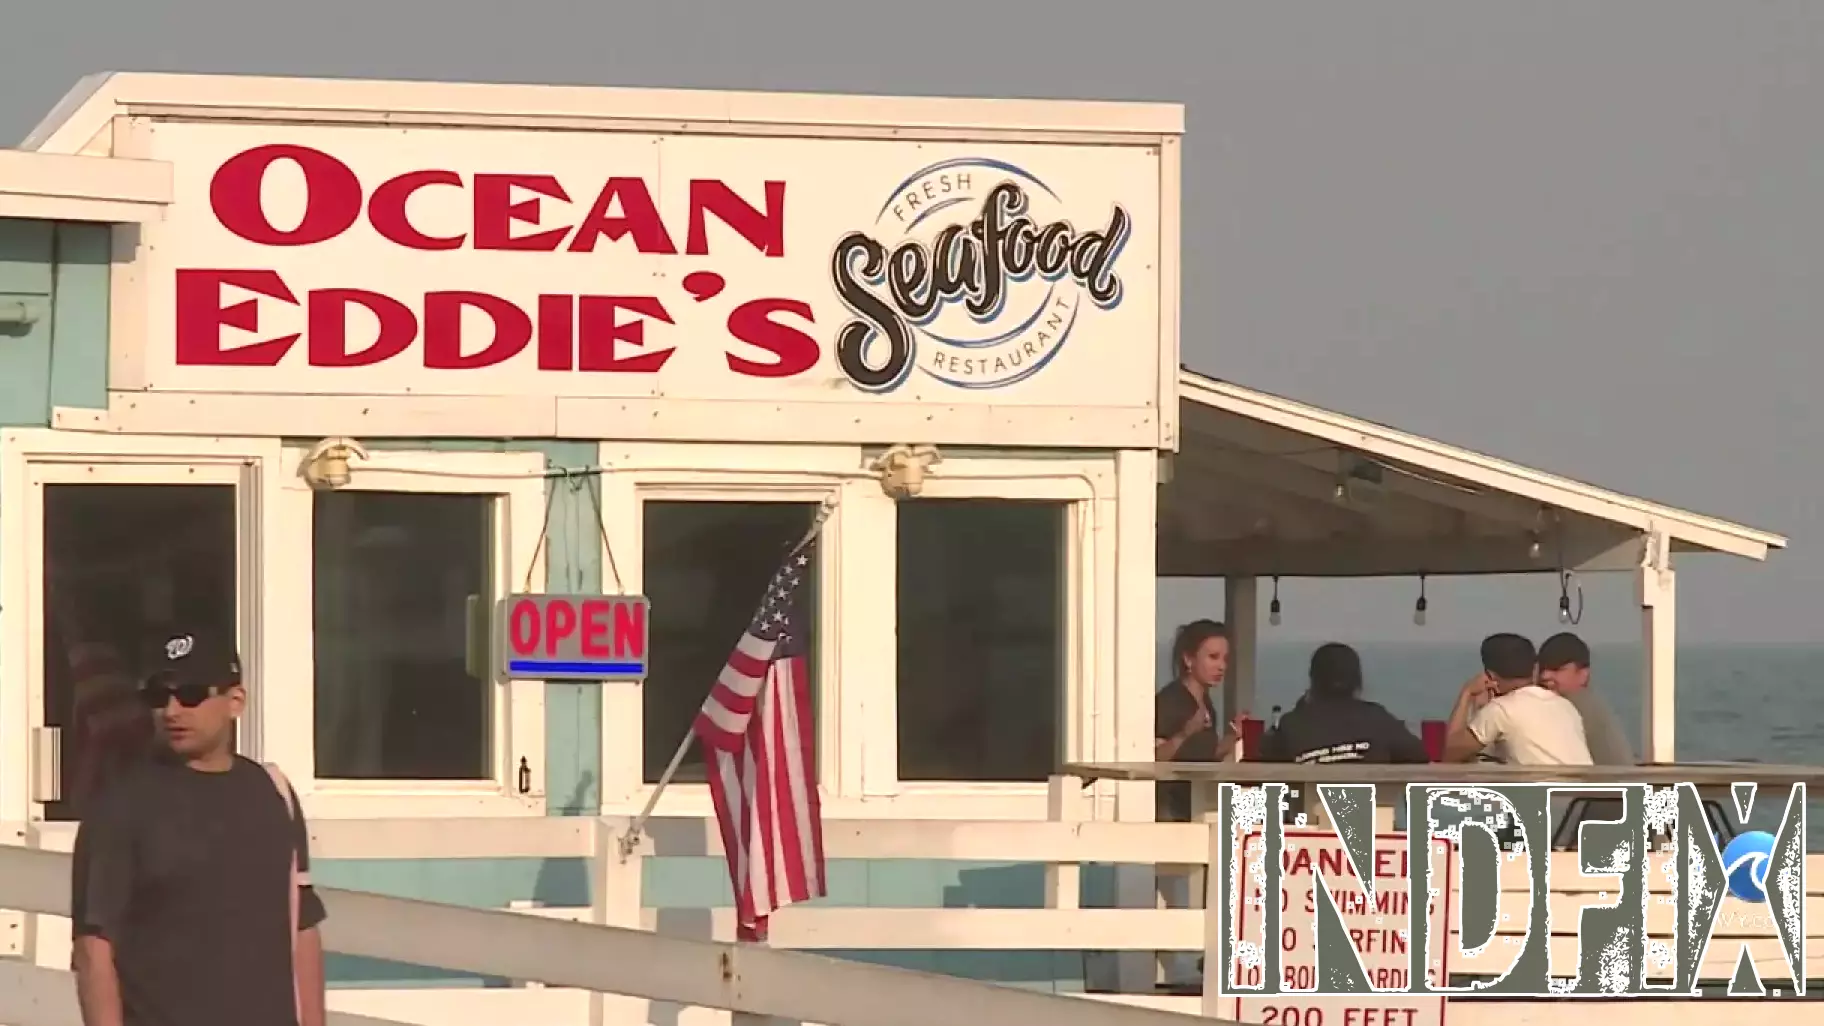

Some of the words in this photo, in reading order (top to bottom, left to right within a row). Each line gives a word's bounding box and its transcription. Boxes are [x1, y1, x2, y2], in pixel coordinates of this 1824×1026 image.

[209, 143, 786, 257] OCEAN
[893, 173, 972, 222] FRESH
[175, 268, 820, 378] EDDIE'S
[832, 180, 1131, 392] Seafood
[933, 296, 1071, 375] RESTAURANT
[509, 598, 645, 659] OPEN
